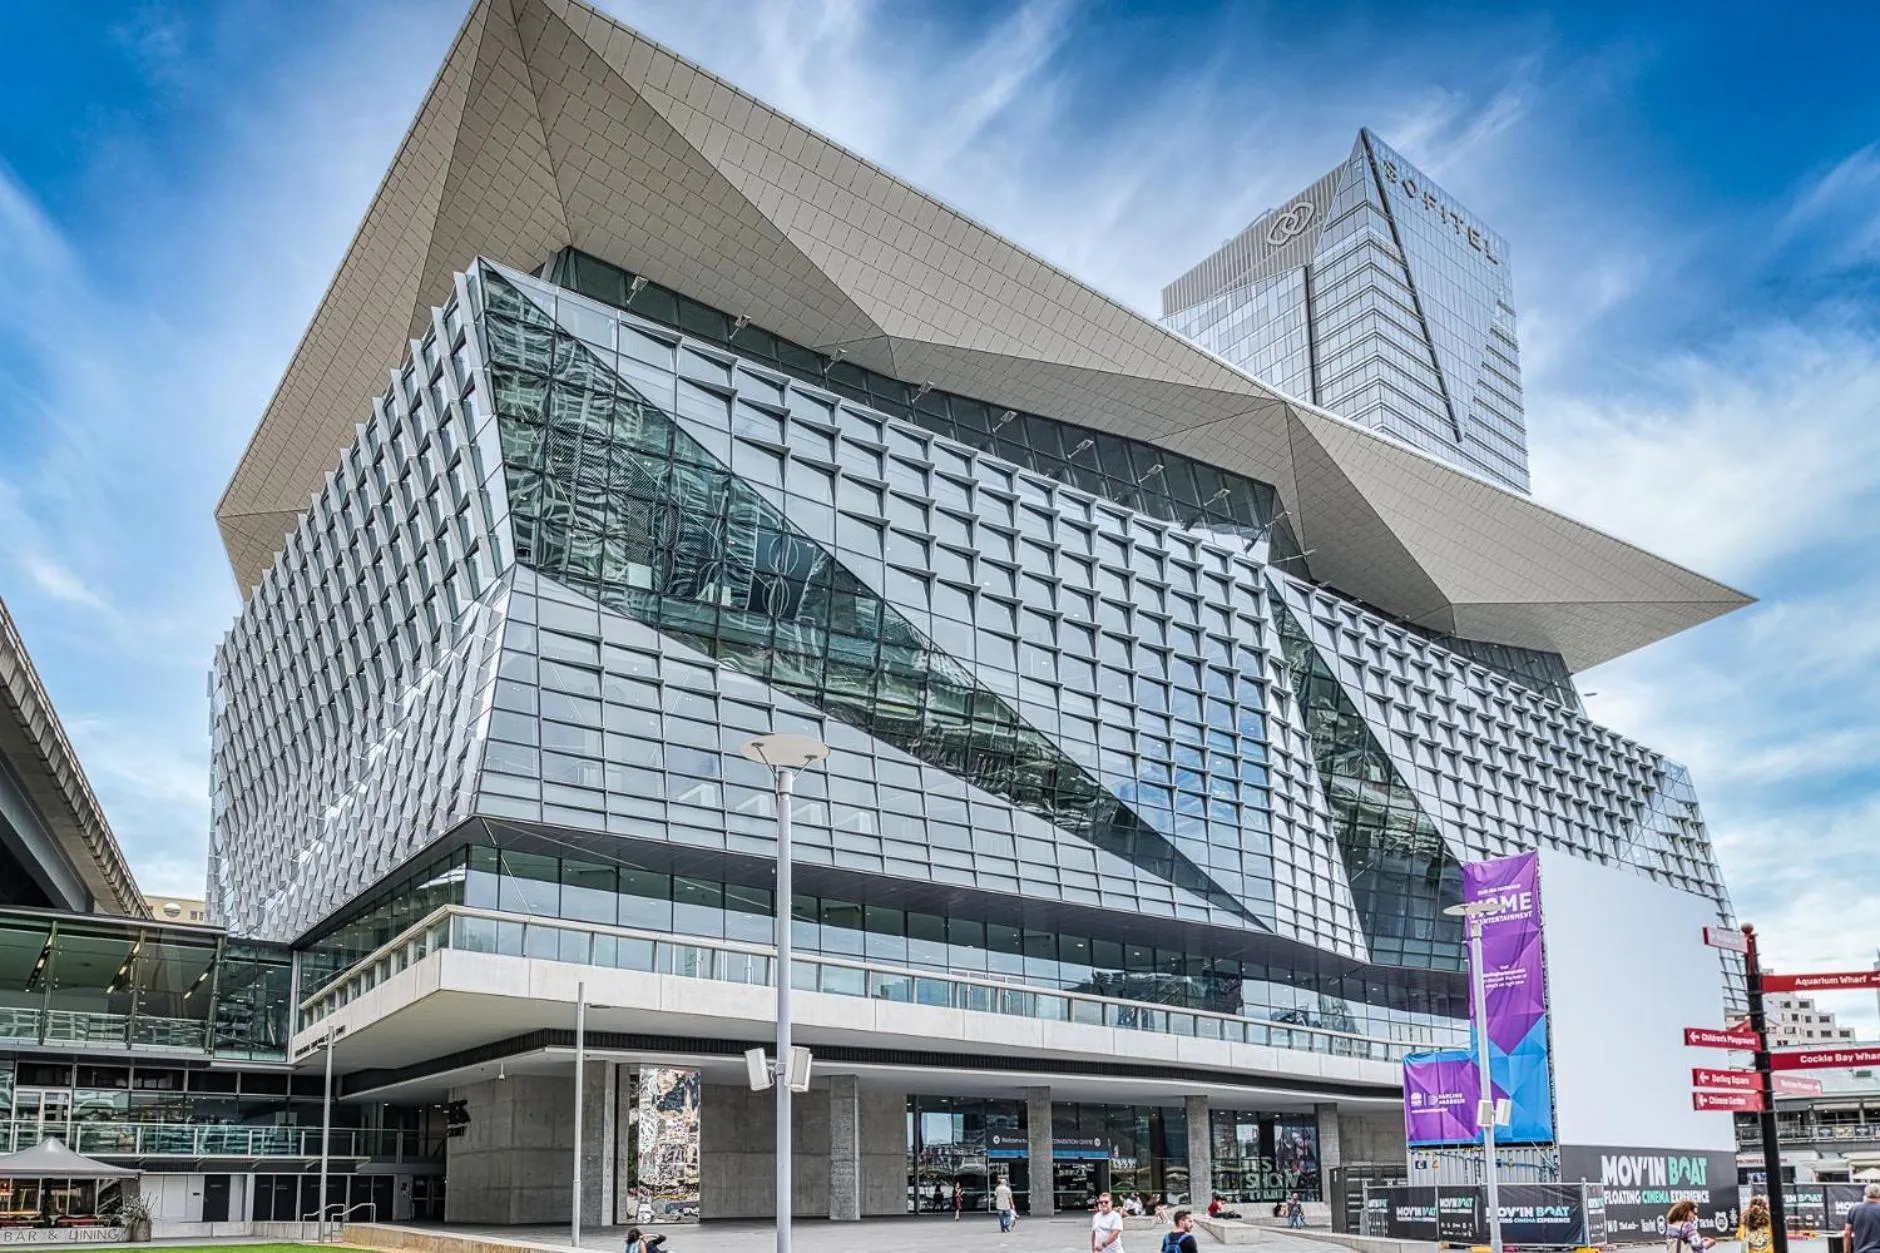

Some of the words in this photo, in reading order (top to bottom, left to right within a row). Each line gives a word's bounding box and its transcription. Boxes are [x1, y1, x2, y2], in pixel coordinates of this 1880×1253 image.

[1384, 159, 1499, 265] SOFITEL
[1795, 977, 1838, 986] Aquarium
[1839, 975, 1867, 984] Wharf
[1727, 1035, 1755, 1046] Playground
[1800, 1053, 1833, 1064] Cockle
[1835, 1053, 1855, 1063] Bay
[1855, 1051, 1880, 1061] Whar
[1601, 1155, 1667, 1187] MOV'IN
[1667, 1156, 1708, 1186] BOAT
[1603, 1190, 1641, 1204] FLOATING
[1642, 1190, 1669, 1204] CINEMA
[1670, 1190, 1710, 1203] EXPERIENCE
[1536, 1206, 1570, 1218] BOAT
[4, 1230, 37, 1242] BAR
[48, 1228, 58, 1240] &
